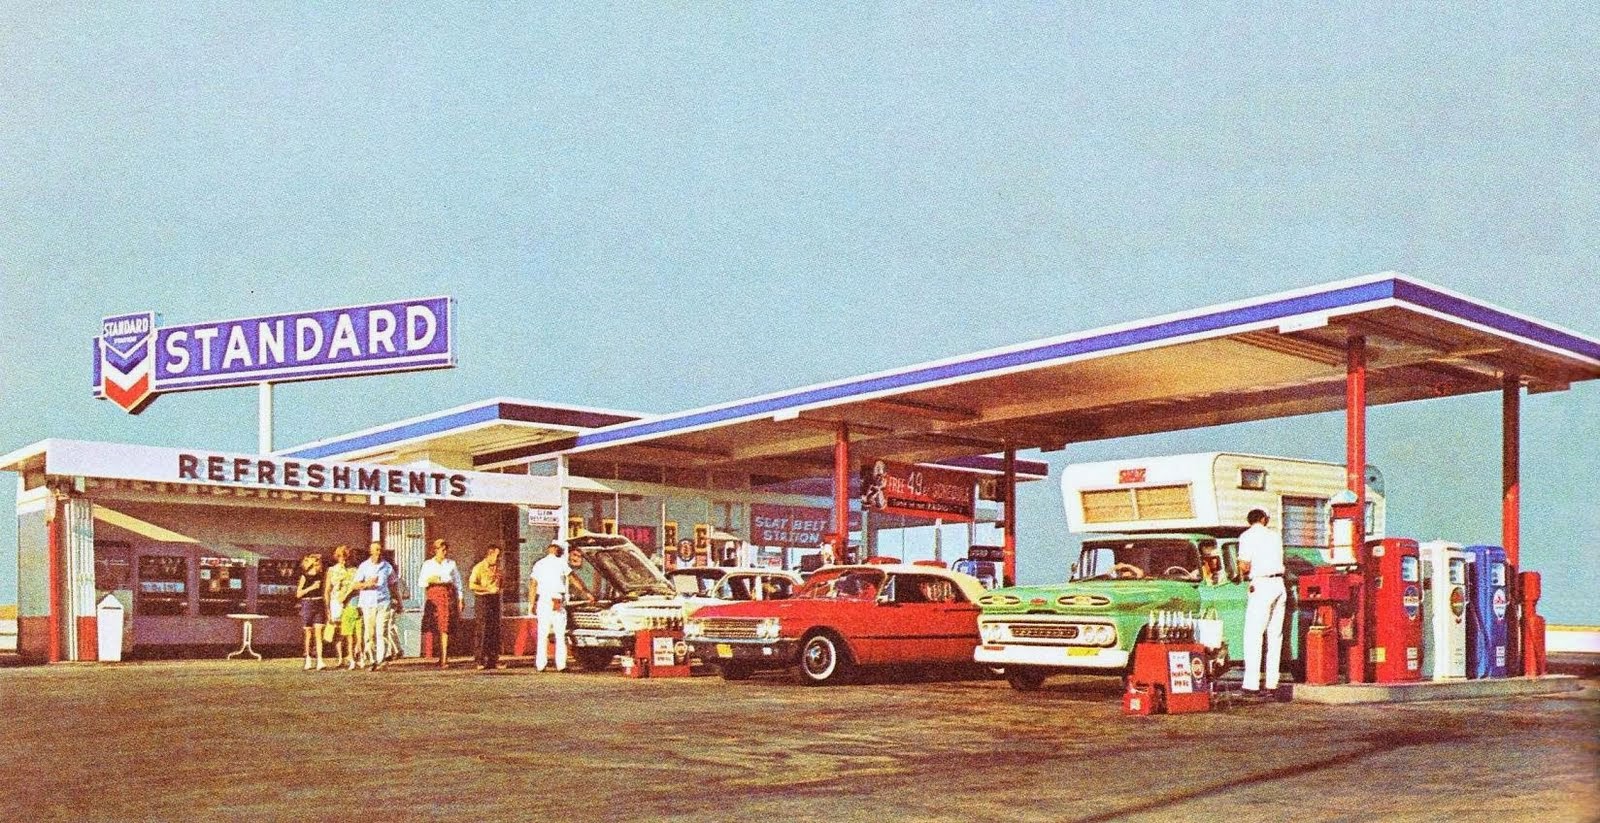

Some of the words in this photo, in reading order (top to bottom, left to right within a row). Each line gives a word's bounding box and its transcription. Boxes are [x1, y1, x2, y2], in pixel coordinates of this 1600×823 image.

[104, 317, 149, 337] STANDARD
[165, 304, 438, 375] STANDARD
[178, 453, 468, 498] REFRESHMENTS
[888, 475, 906, 494] FREE
[755, 516, 788, 529] SEAT
[792, 519, 827, 531] BELT
[763, 530, 820, 543] STATION
